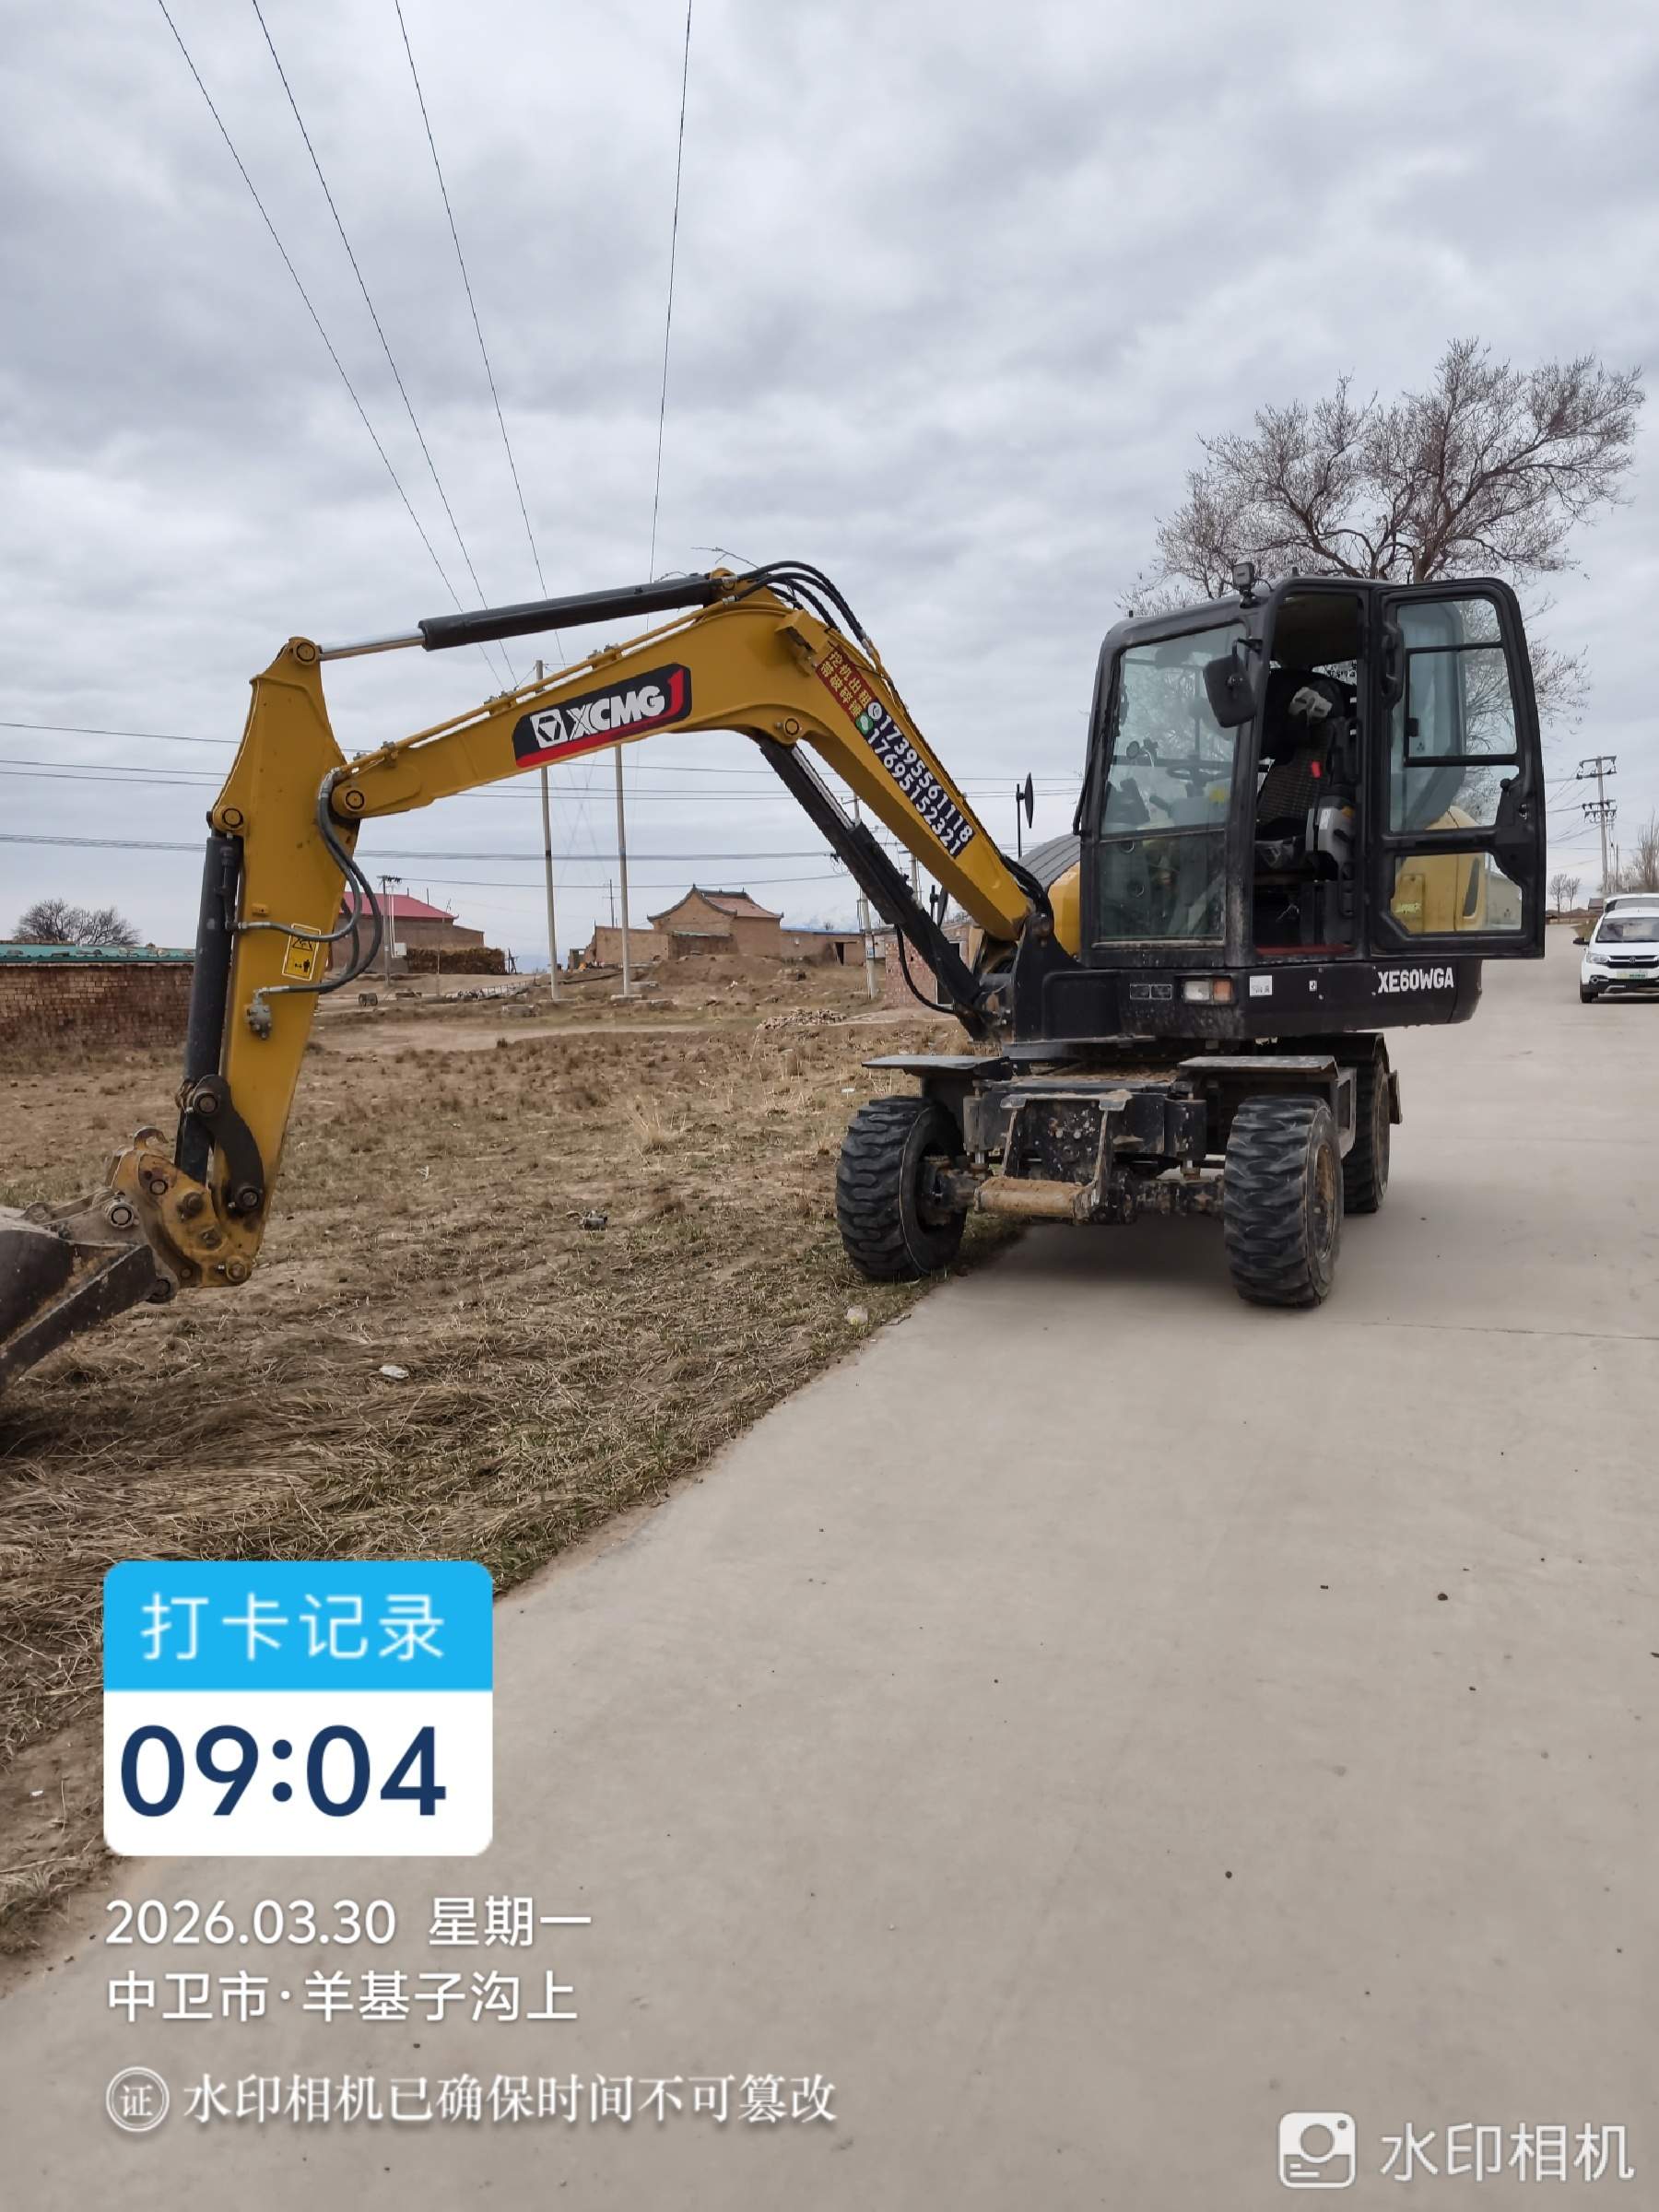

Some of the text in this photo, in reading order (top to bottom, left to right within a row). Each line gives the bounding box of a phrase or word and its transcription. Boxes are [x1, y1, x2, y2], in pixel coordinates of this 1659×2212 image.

[829, 651, 872, 709] 挖机出租
[566, 685, 665, 741] XCMG
[867, 728, 961, 855] 17695152321
[878, 714, 973, 843] 17395561118
[1377, 966, 1454, 994] XE60WGA
